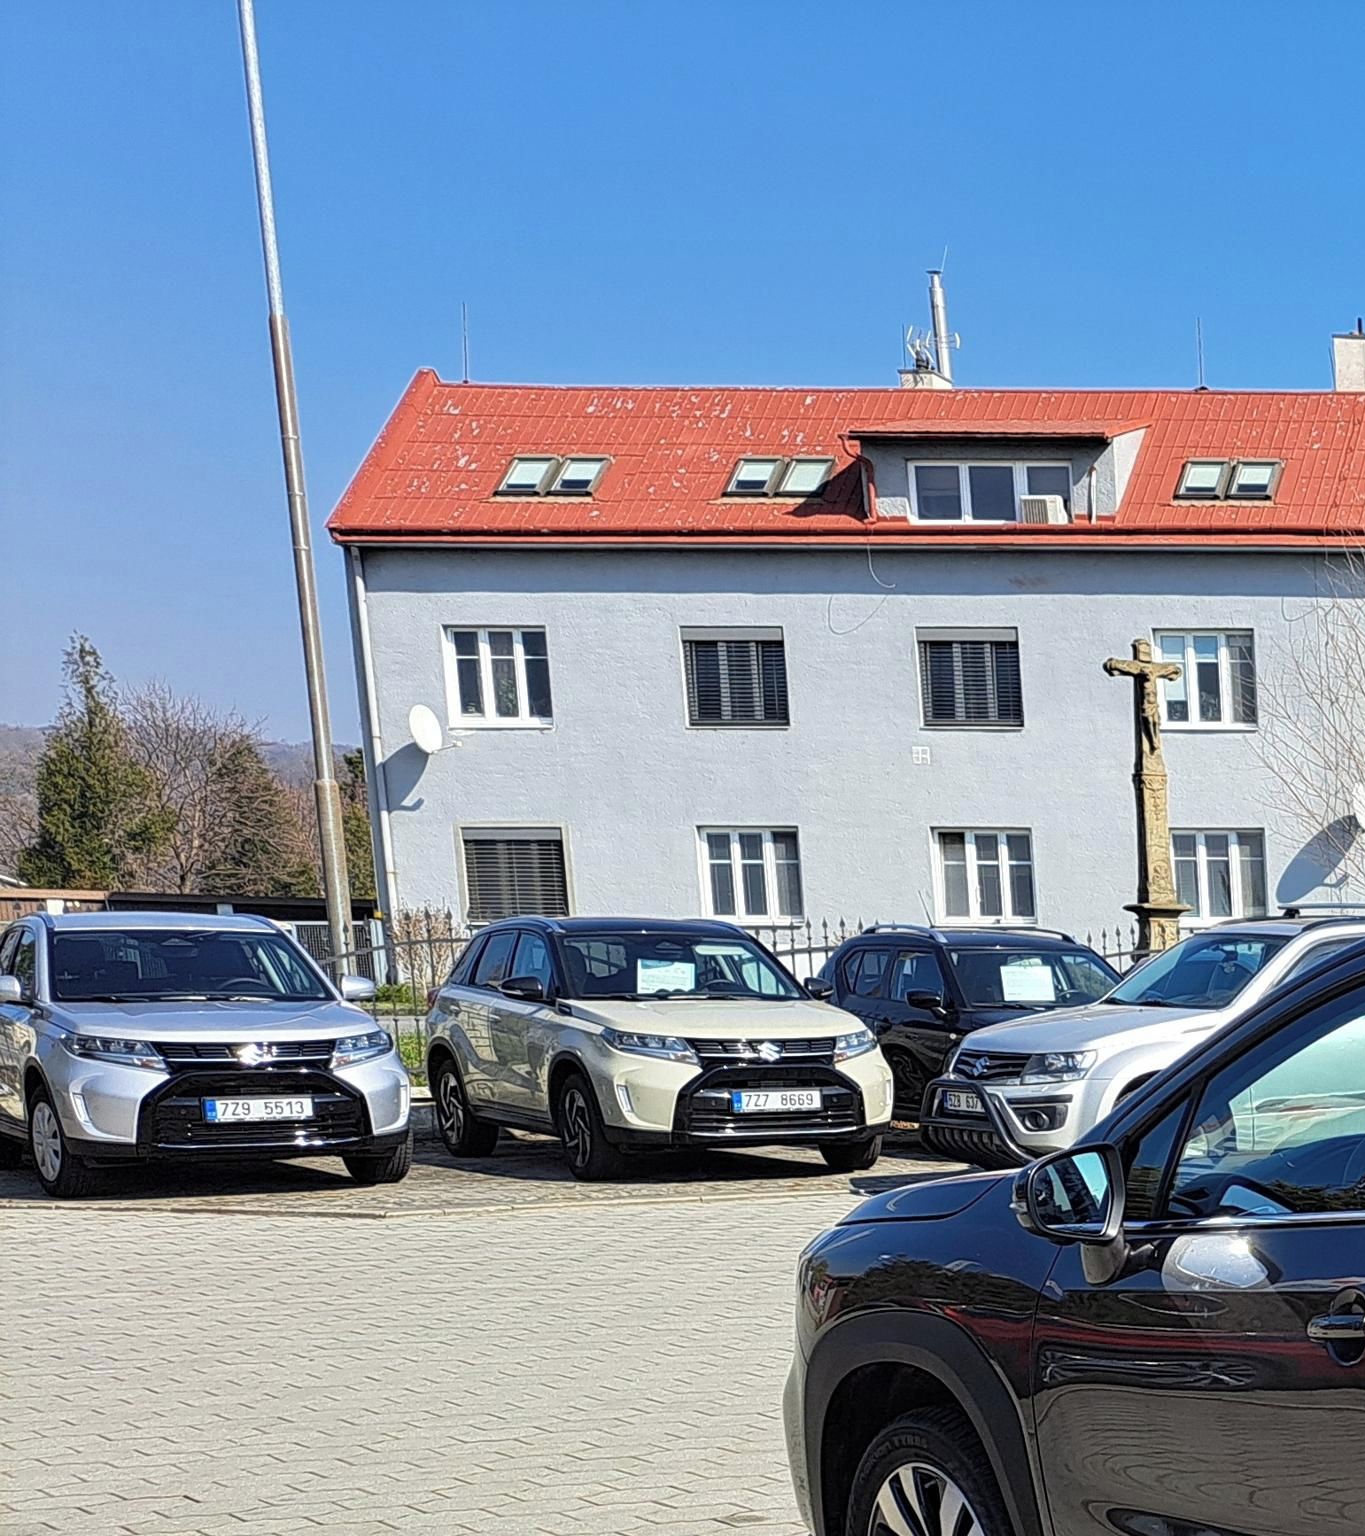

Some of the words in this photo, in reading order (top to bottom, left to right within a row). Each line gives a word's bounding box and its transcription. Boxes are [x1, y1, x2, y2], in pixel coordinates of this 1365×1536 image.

[745, 1094, 770, 1107] 7Z7
[780, 1093, 814, 1106] 8669
[965, 1095, 980, 1109] 637
[220, 1101, 251, 1117] 7Z9
[264, 1101, 305, 1115] 5513
